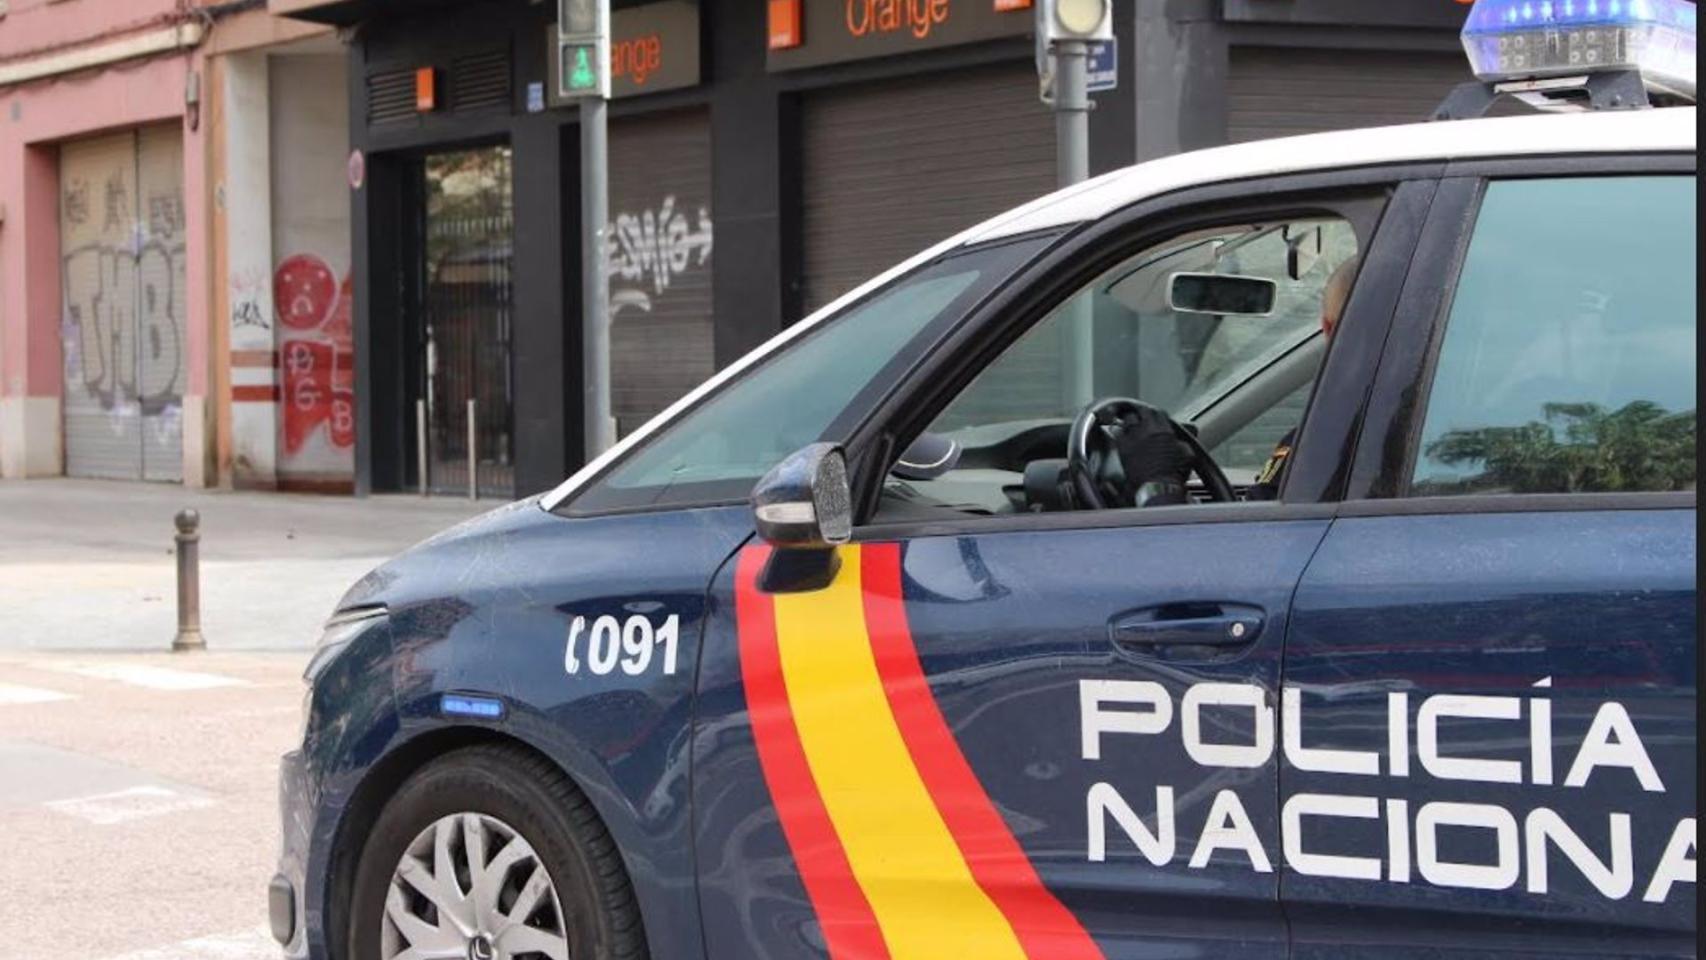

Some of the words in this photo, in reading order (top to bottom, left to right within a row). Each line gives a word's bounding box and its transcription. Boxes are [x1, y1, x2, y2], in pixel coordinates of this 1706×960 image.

[611, 35, 661, 84] ange
[588, 614, 679, 675] 091
[1079, 676, 1666, 792] POLICÍA
